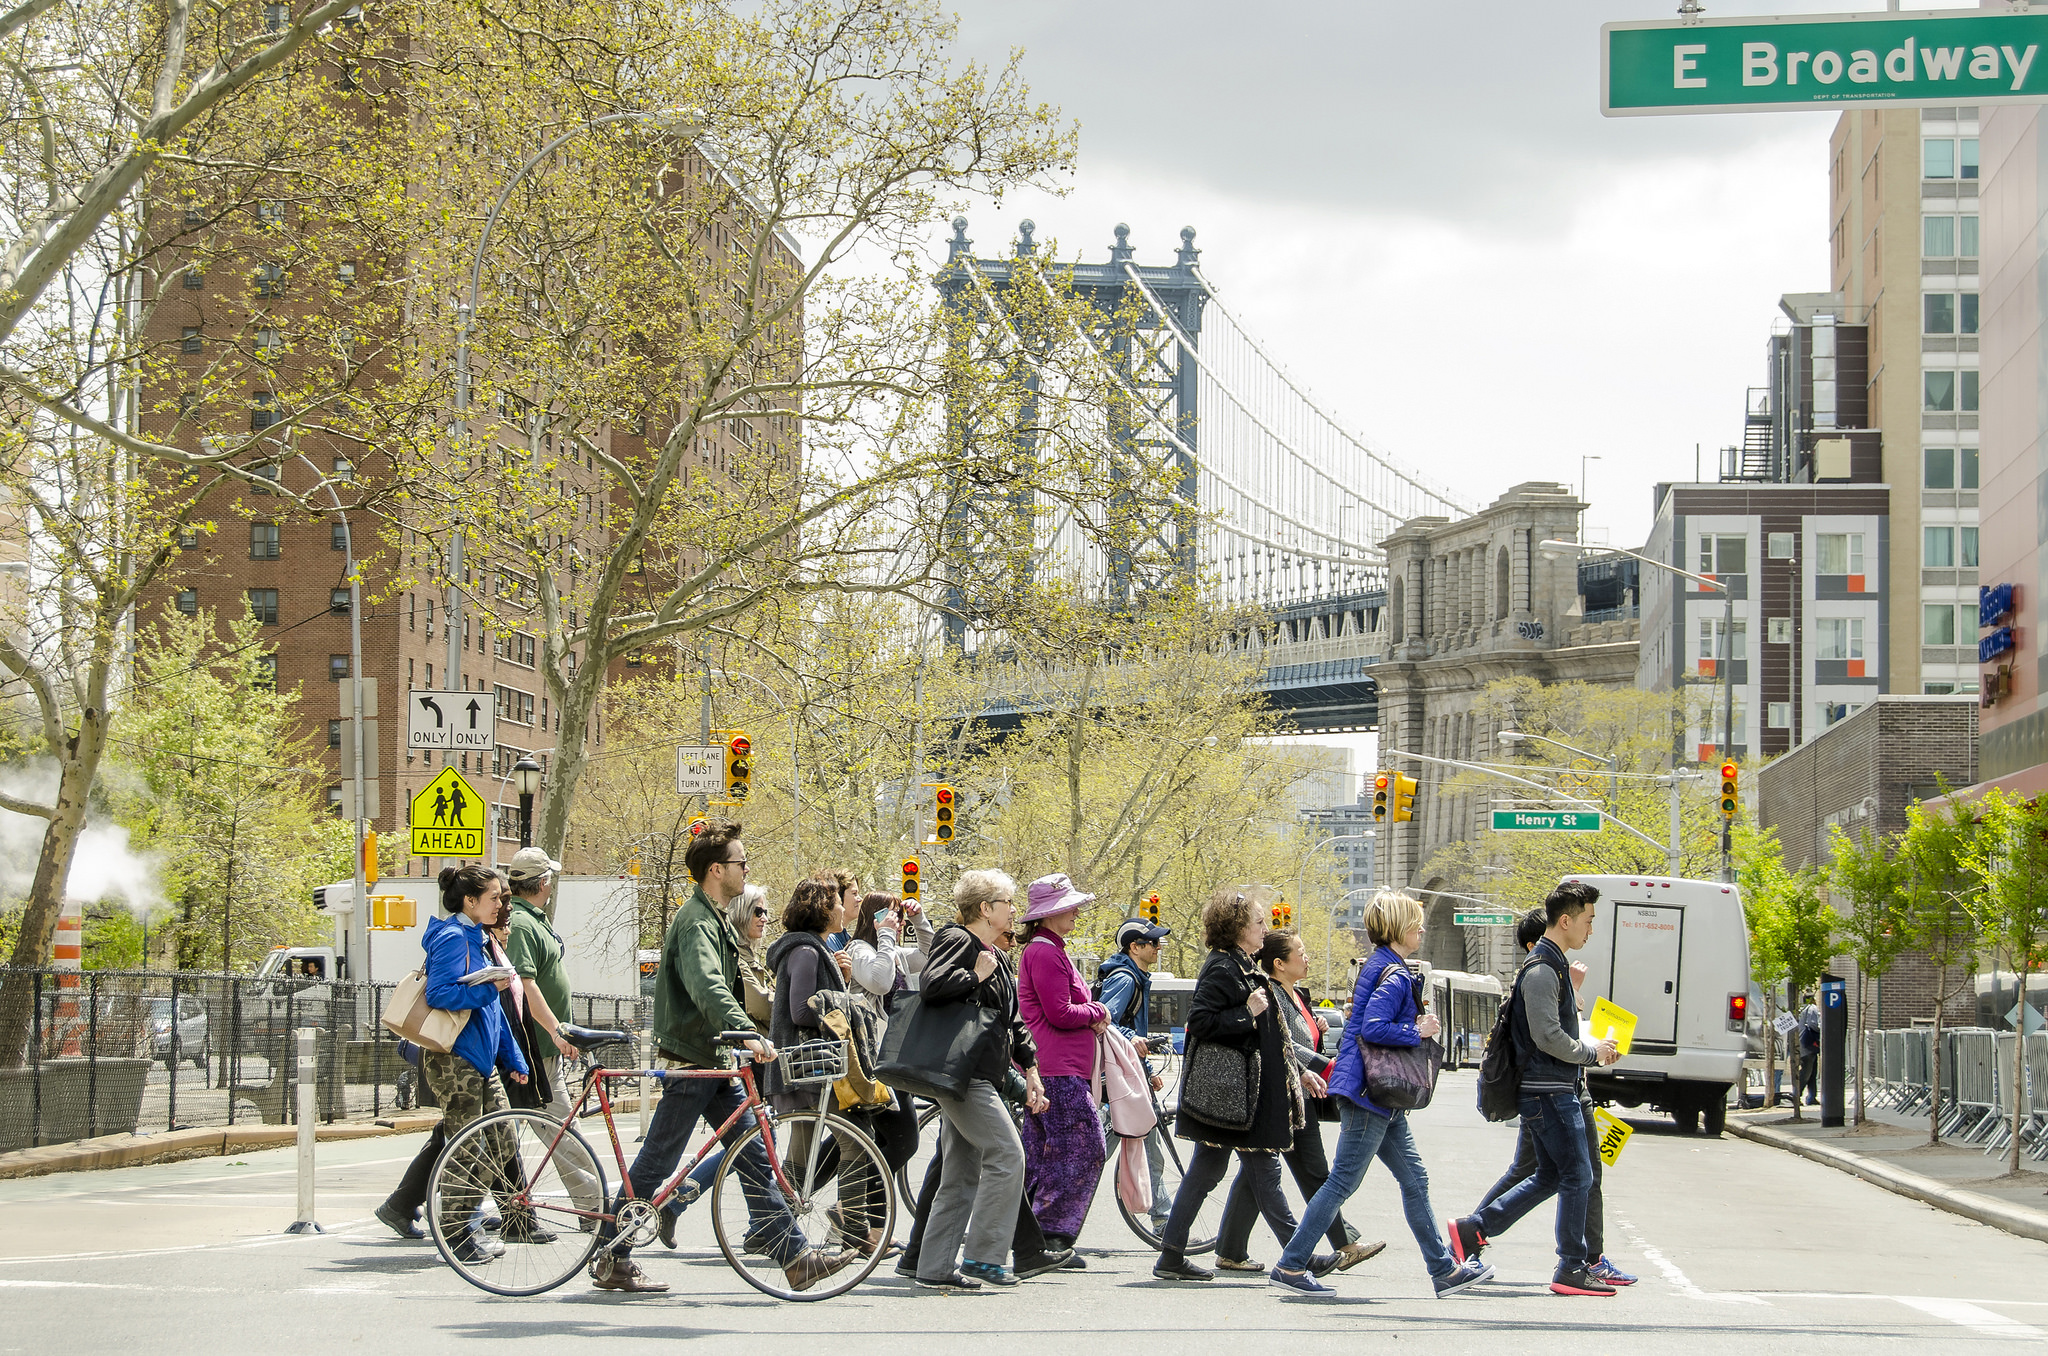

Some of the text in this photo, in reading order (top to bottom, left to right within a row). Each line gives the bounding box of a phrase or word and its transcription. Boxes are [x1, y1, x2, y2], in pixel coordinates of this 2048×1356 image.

[1673, 36, 2039, 91] E Broadway
[413, 731, 446, 744] ONLY
[456, 732, 489, 745] ONLY
[681, 752, 698, 761] LEFT
[688, 765, 712, 775] MUST
[681, 780, 720, 788] TURN LEFT
[1515, 813, 1577, 828] Henry St
[419, 832, 476, 850] AHEAD
[1830, 992, 1839, 1006] P
[1600, 1124, 1626, 1158] MAS
